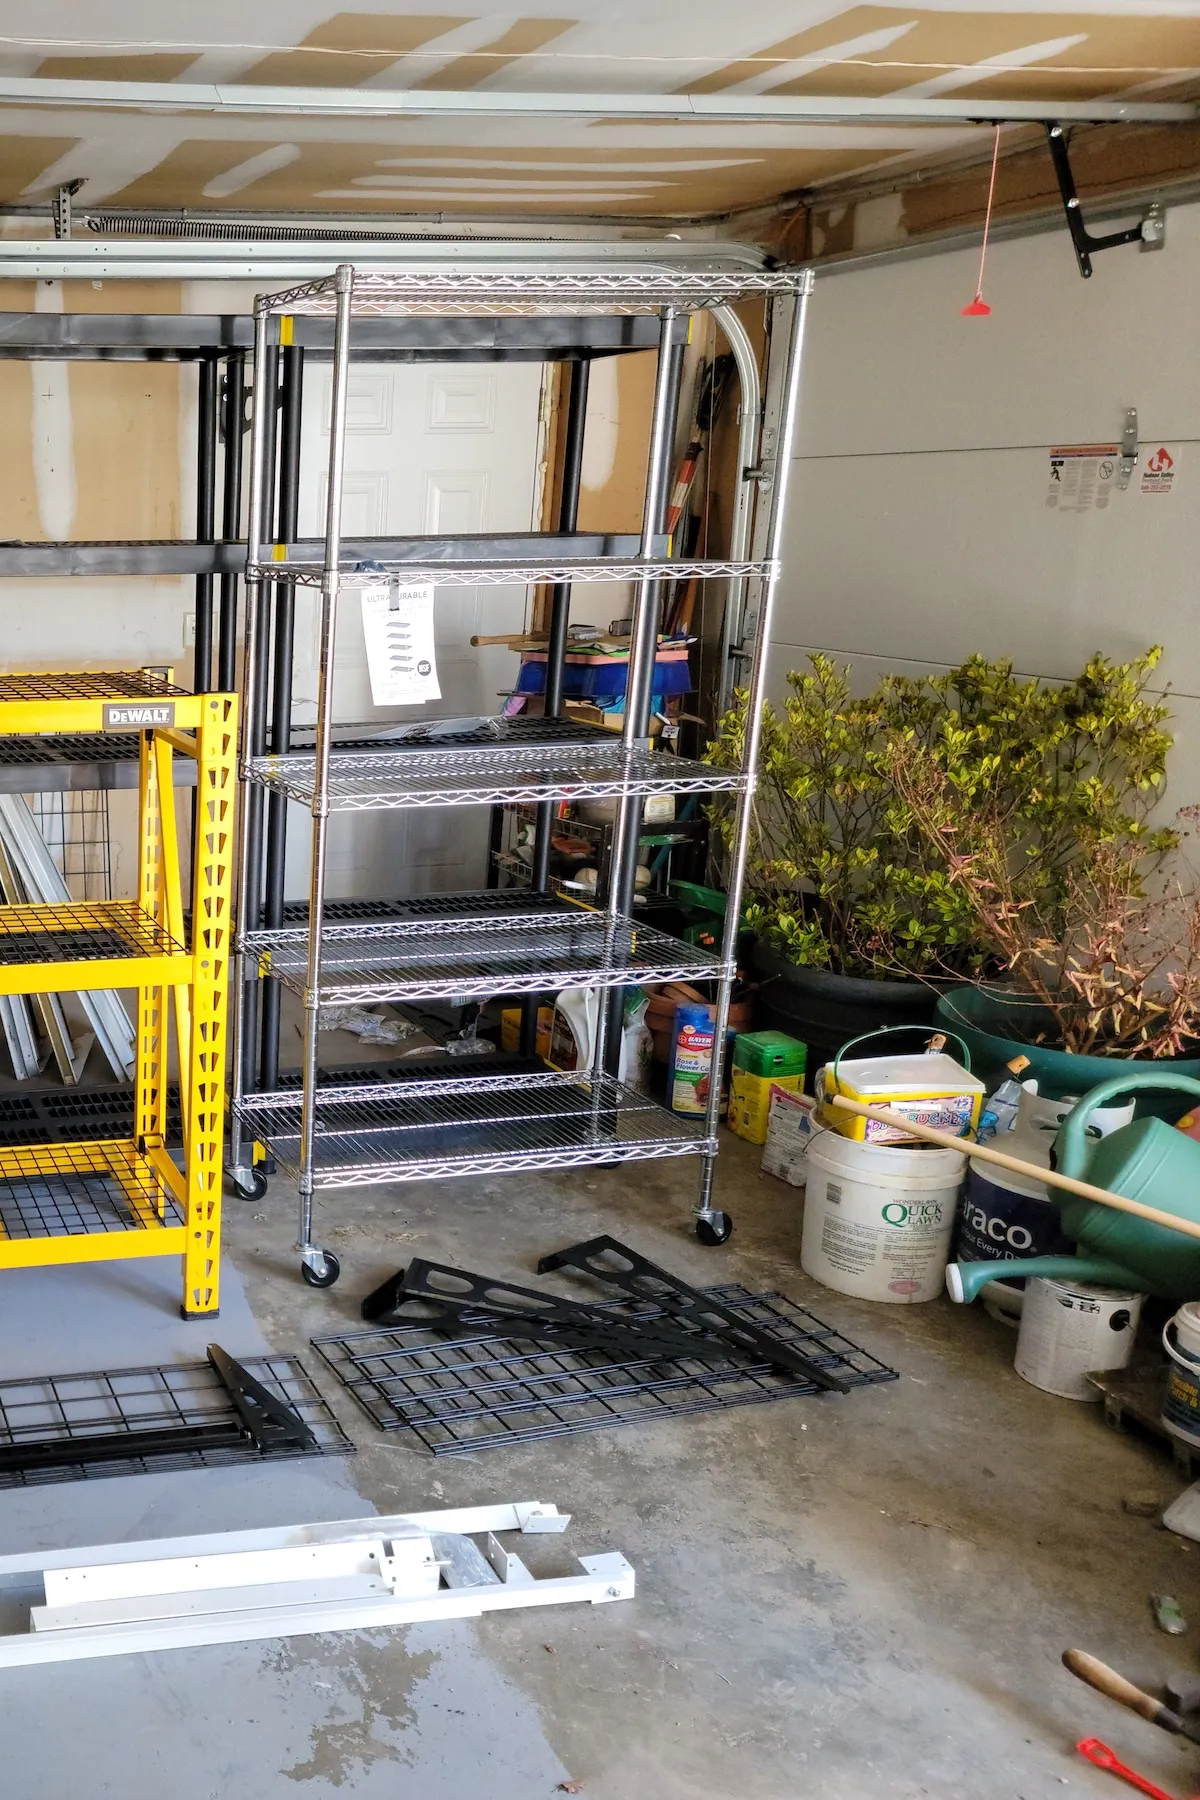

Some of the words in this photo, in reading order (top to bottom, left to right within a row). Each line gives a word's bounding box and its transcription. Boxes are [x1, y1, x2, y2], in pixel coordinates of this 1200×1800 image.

[398, 590, 427, 601] URABLE
[676, 1057, 691, 1065] Rose
[676, 1063, 699, 1071] Flower
[881, 1203, 944, 1228] QUICK
[907, 1214, 942, 1225] LAWN
[976, 1237, 1003, 1259] Every
